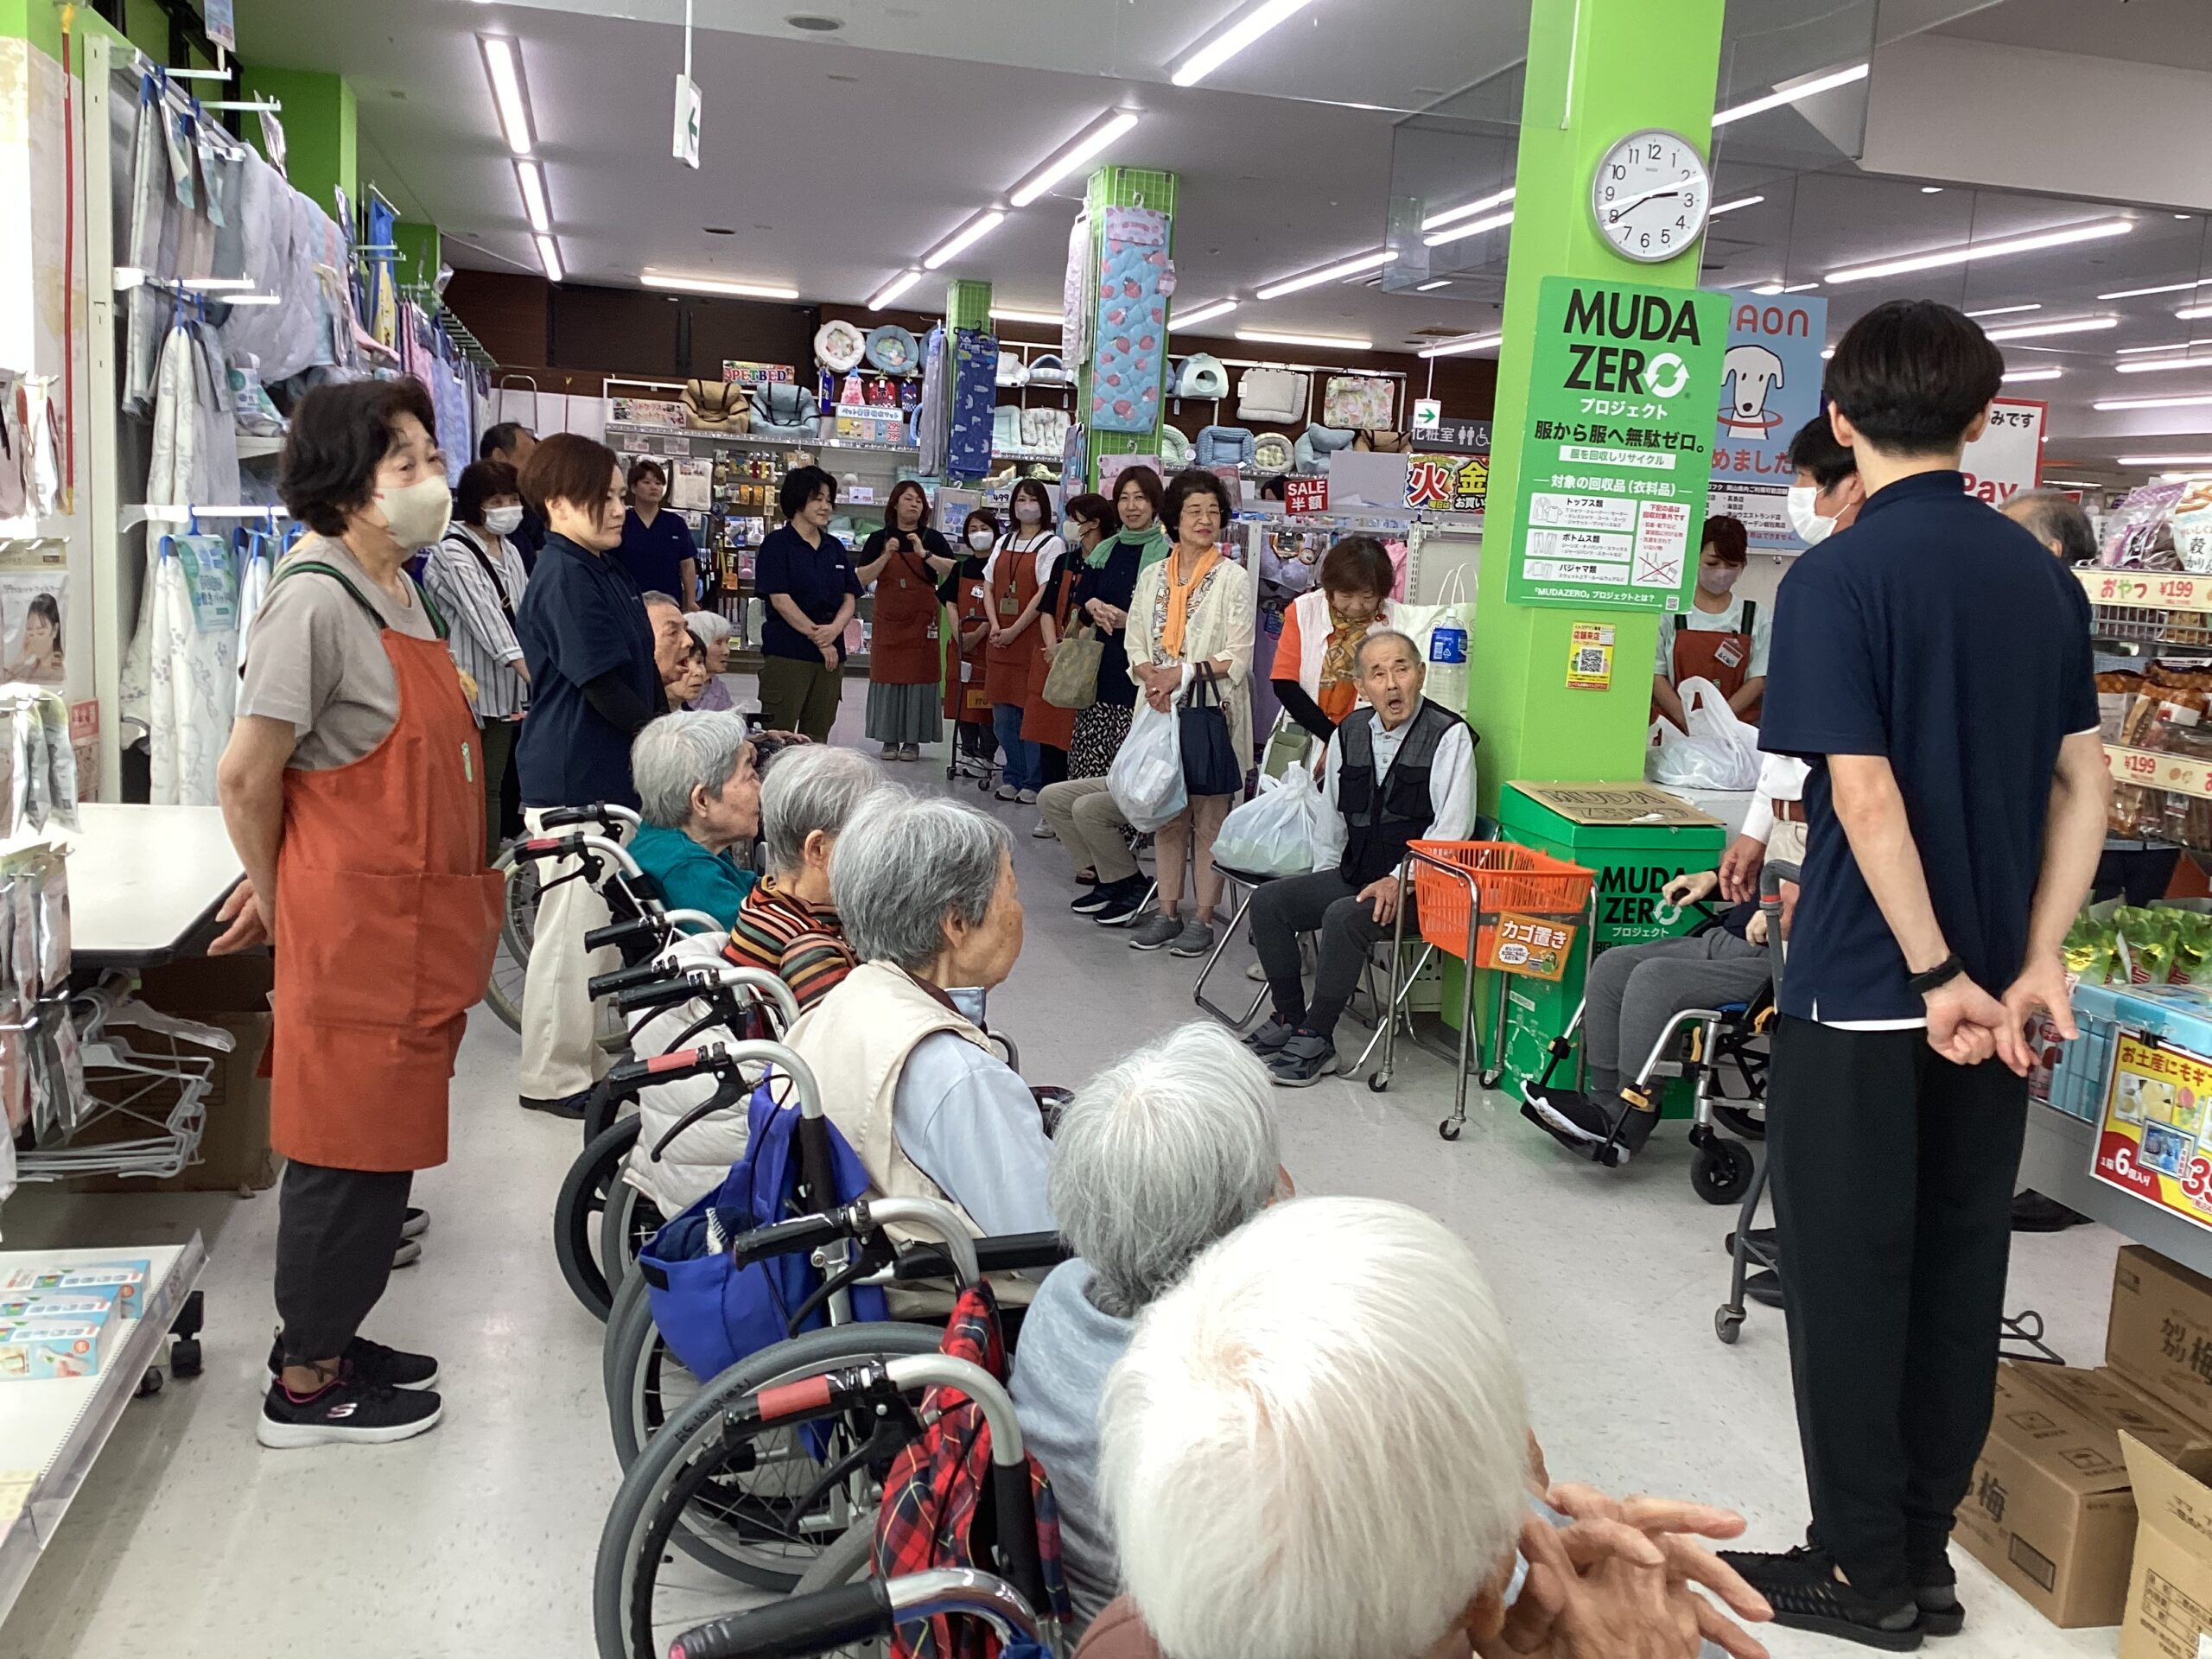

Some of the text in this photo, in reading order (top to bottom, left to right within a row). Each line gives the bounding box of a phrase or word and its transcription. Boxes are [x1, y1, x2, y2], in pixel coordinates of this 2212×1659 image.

[1629, 148, 1639, 164] 11
[1648, 144, 1661, 160] 12
[1672, 153, 1675, 168] 1
[1612, 164, 1625, 180] 10
[1681, 169, 1690, 182] 2
[1605, 187, 1615, 201] 9
[1684, 194, 1694, 207] 3
[1610, 210, 1618, 223] 8
[1675, 215, 1685, 229] 4
[1624, 226, 1632, 240] 7
[1641, 233, 1649, 247] 6
[1662, 229, 1670, 243] 5
[1563, 289, 1700, 346] MUDA
[1737, 304, 1808, 337] AON
[1580, 397, 1668, 420] プロジェクト
[1988, 410, 2035, 429] みです
[1411, 428, 1455, 442] 化粧室
[1535, 420, 1705, 454] 服から服へ無駄ゼロ。
[1570, 448, 1664, 466] 服を回収しリサイクル
[1712, 448, 1796, 474] めました
[1408, 463, 1449, 505] 火
[1458, 461, 1488, 493] 金
[1288, 481, 1325, 496] SALE
[1292, 495, 1322, 511] 半額
[1455, 497, 1485, 509] お買い
[1567, 498, 1603, 507] トップス類
[1563, 533, 1600, 543] ボトムス類
[1560, 564, 1597, 573] パジャマ類
[2101, 579, 2148, 599] おやつ
[2160, 581, 2193, 597] ¥199
[2125, 755, 2156, 773] ¥199
[1539, 791, 1666, 804] MUDA
[1502, 920, 1567, 949] カゴ置き
[1612, 927, 1669, 938] プロジェクト
[2121, 1046, 2212, 1090] お土産にもギ
